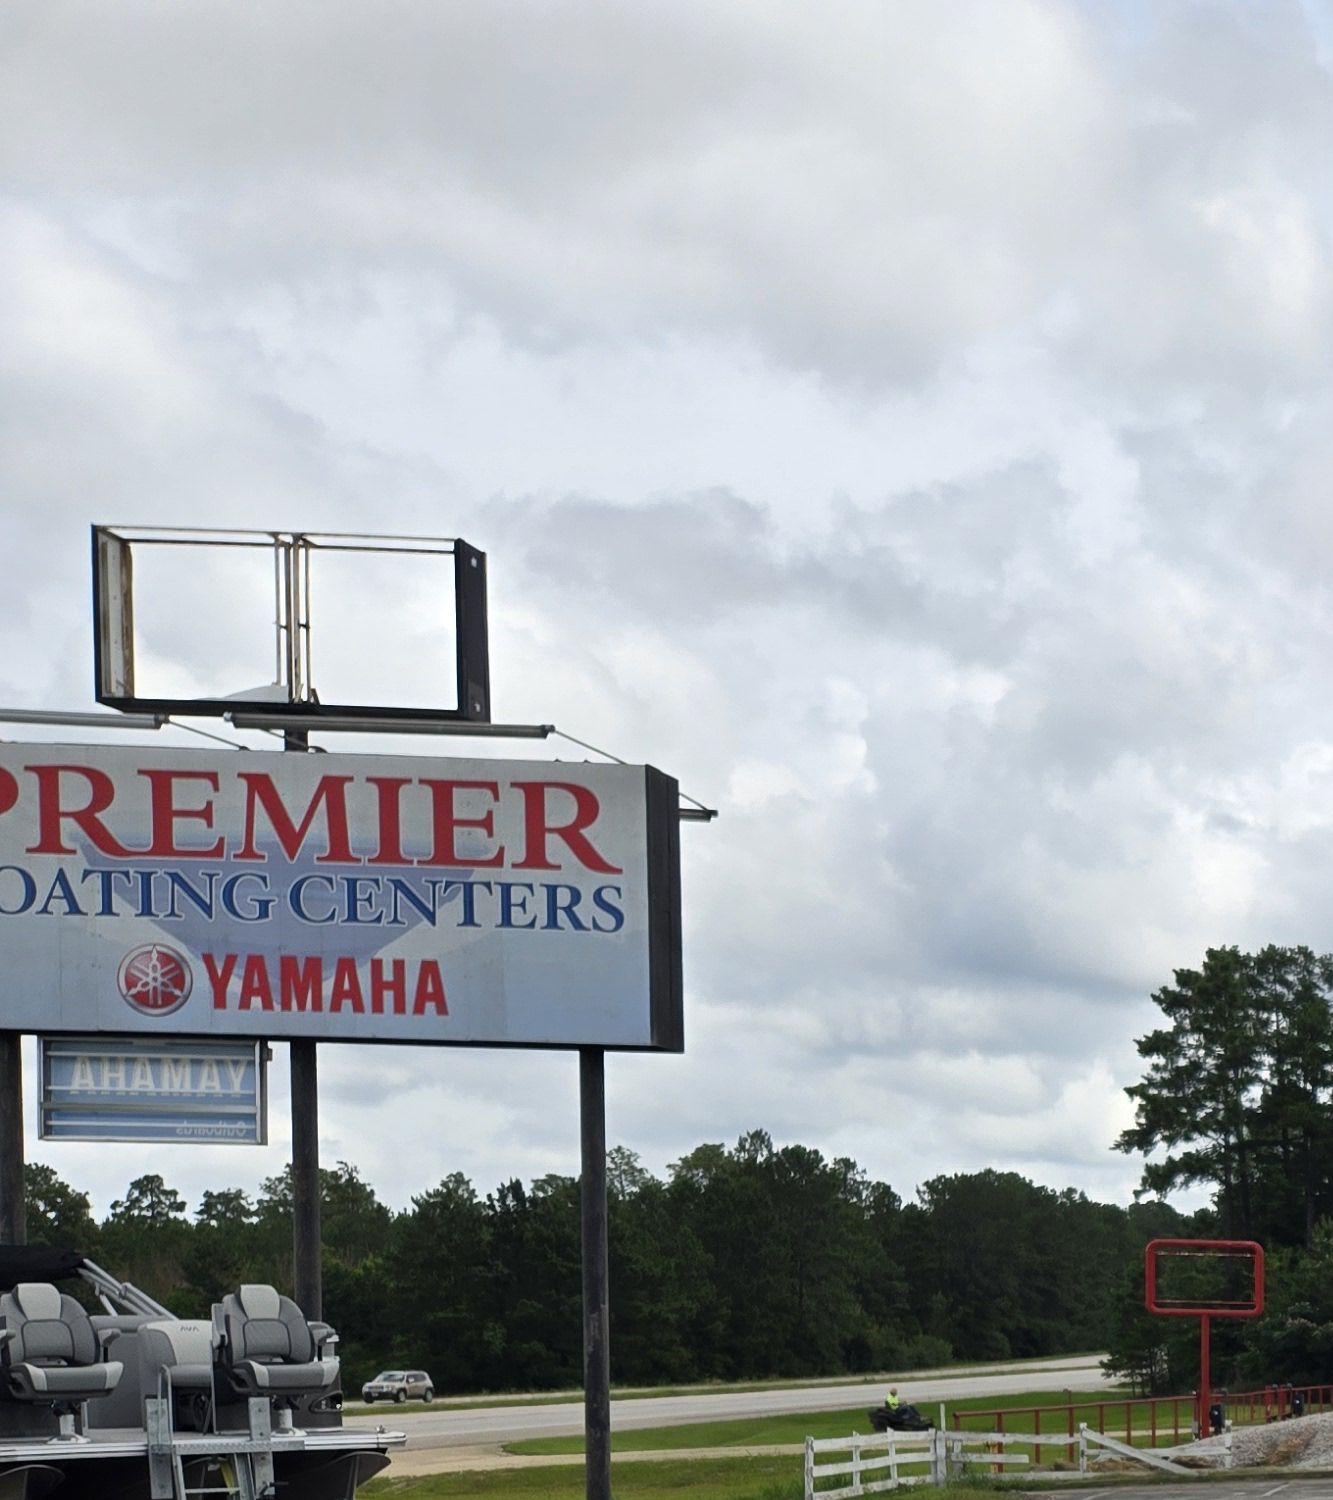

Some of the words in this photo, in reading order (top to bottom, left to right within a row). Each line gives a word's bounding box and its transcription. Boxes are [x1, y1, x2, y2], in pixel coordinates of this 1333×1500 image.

[0, 764, 624, 875] REMIER
[289, 874, 625, 933] CENTERS
[201, 952, 449, 1016] YAMAHA
